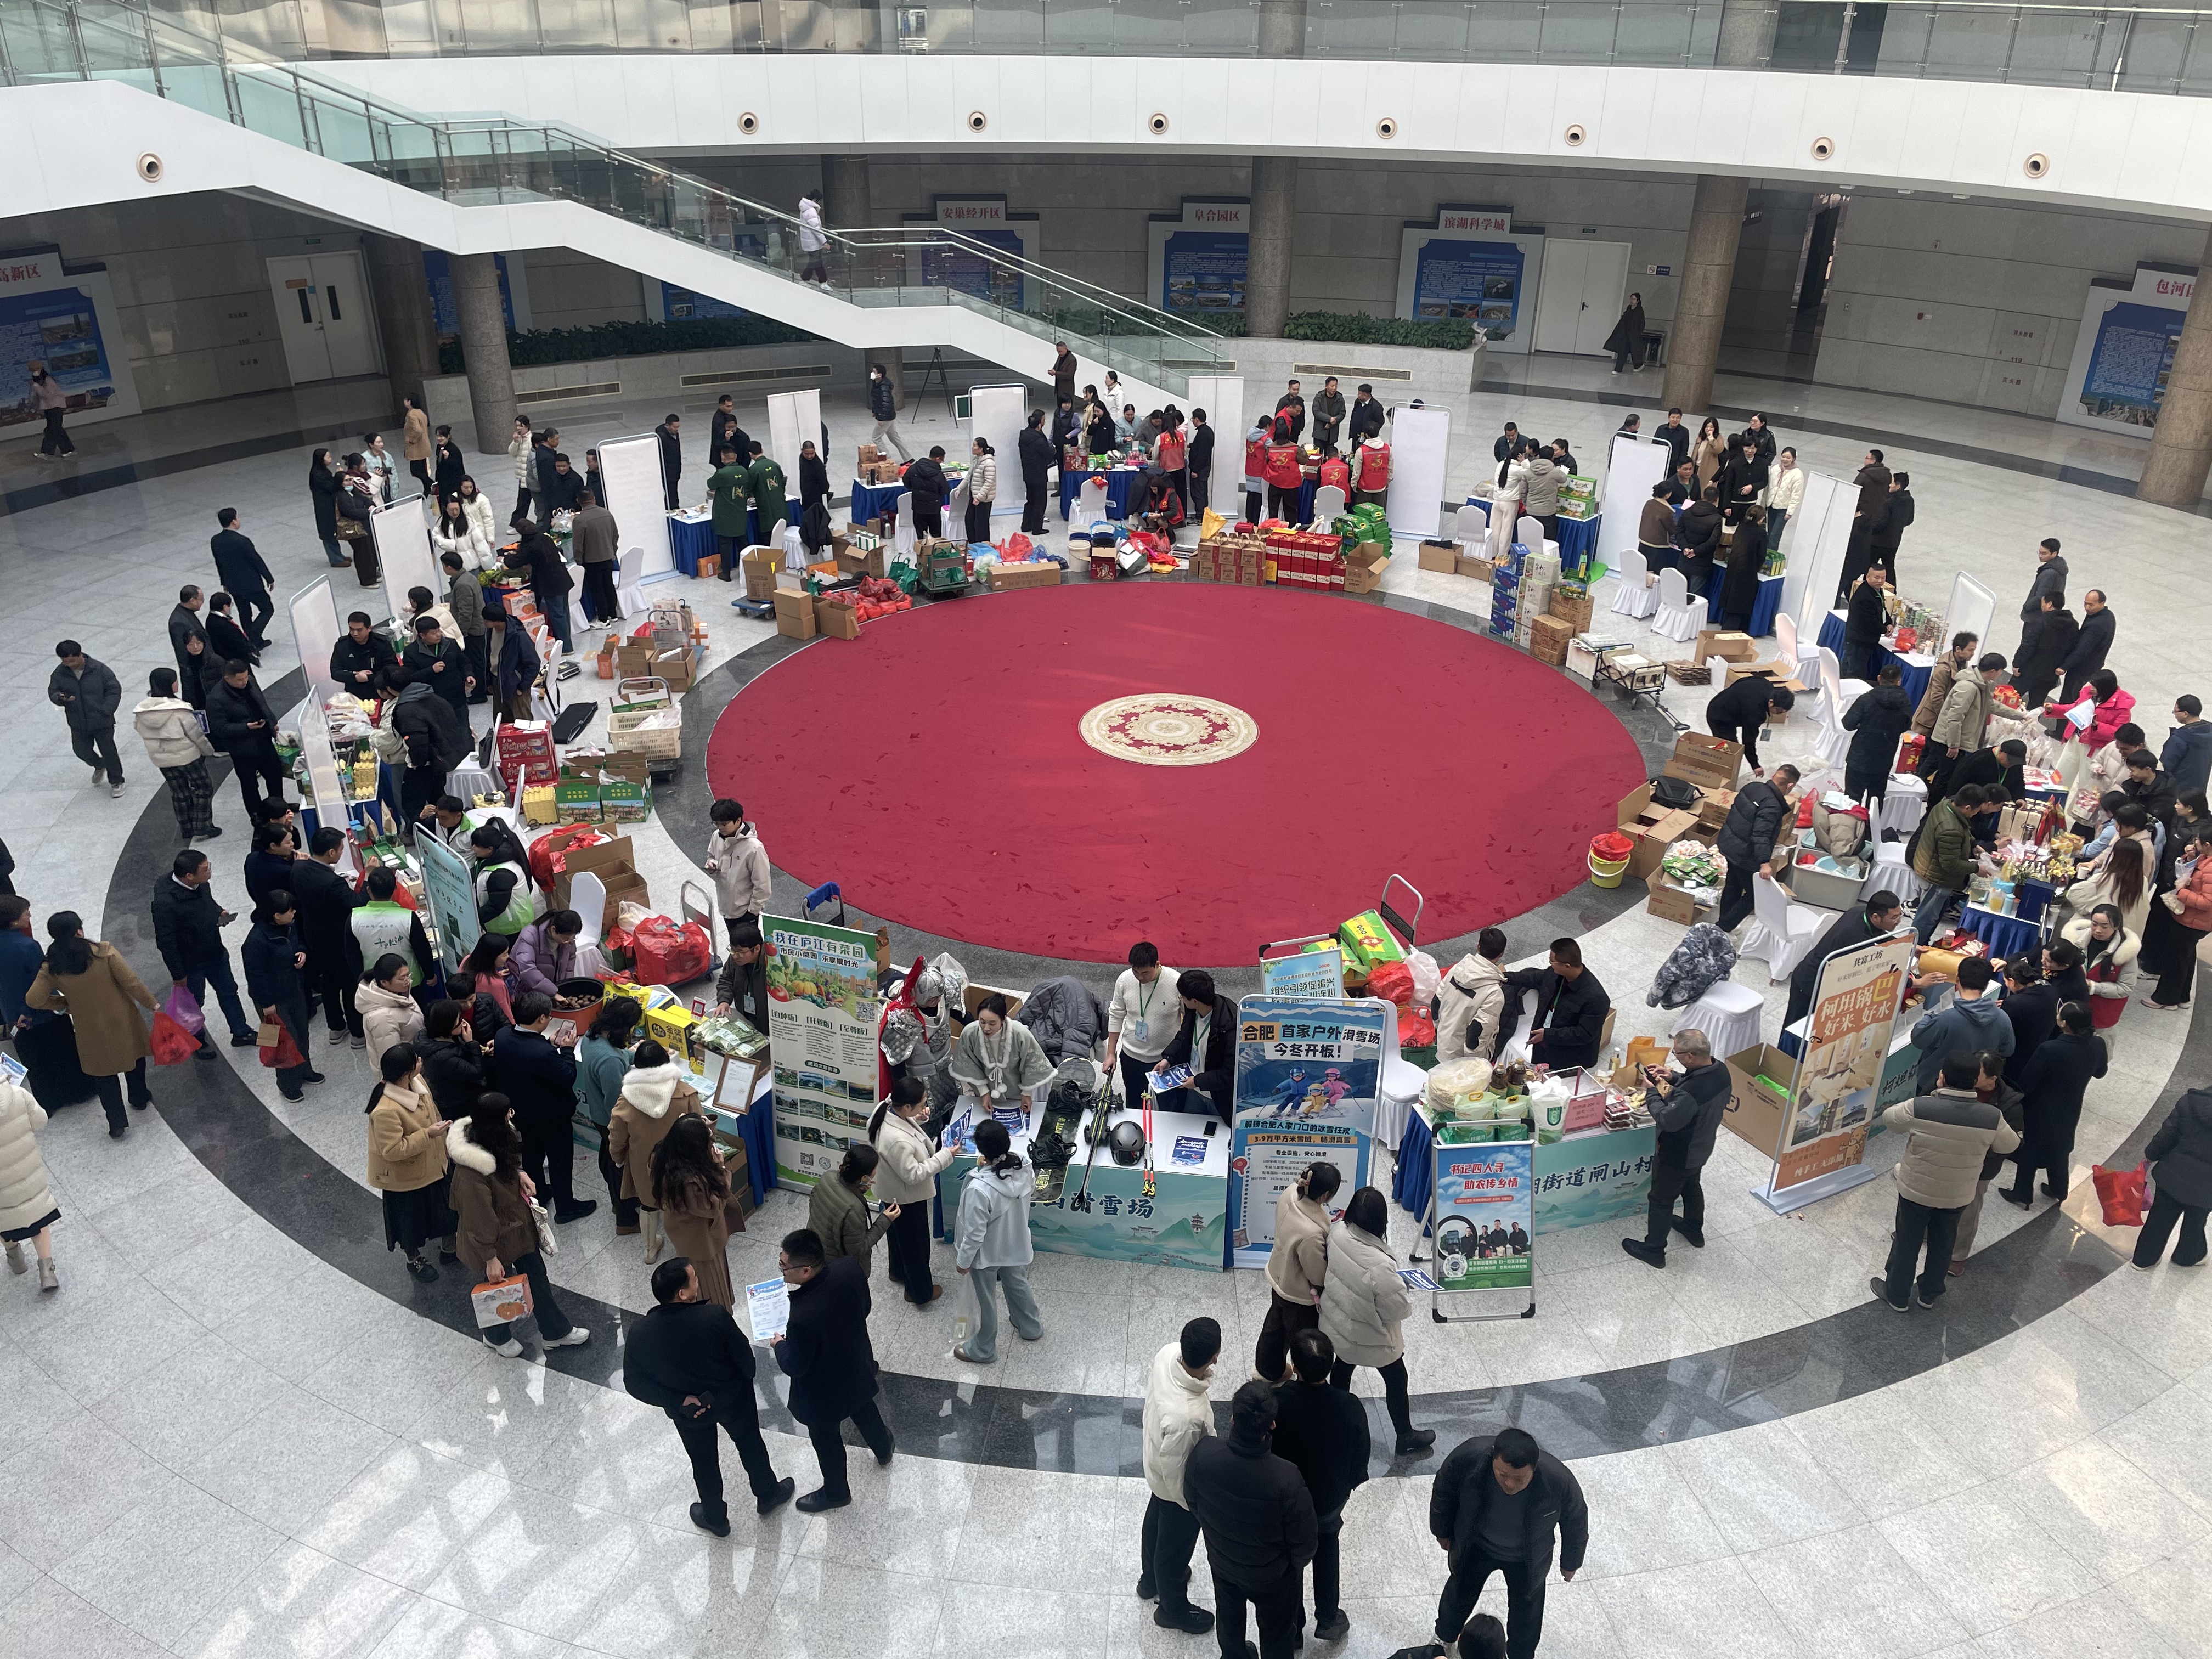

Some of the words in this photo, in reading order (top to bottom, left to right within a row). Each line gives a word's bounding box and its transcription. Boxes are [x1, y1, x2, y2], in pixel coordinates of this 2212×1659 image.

[943, 206, 1001, 219] 安巢经开区
[1194, 208, 1240, 222] 阜合园区
[1444, 216, 1505, 232] 滨湖科学城
[2002, 377, 2022, 385] 灭火器
[775, 932, 864, 958] 我在庐江有菜园
[780, 947, 817, 960] 市民小菜园
[822, 955, 859, 968] 乐享慢时光
[1853, 950, 1884, 968] 共富工坊
[1271, 977, 1335, 995] 组织引领促振兴
[1821, 975, 1894, 1022] 柯坦锅巴
[1860, 1000, 1892, 1026] 好水
[665, 1025, 682, 1039] 金奖
[1243, 1025, 1276, 1041] 合肥
[1281, 1024, 1342, 1041] 首家户外
[1342, 1028, 1381, 1045] 滑雪场
[1244, 1120, 1351, 1135] 解锁合肥人家门口的冰雪狂欢
[1451, 1163, 1504, 1175] 书记四人寻
[1464, 1177, 1518, 1190] 助农传乡情
